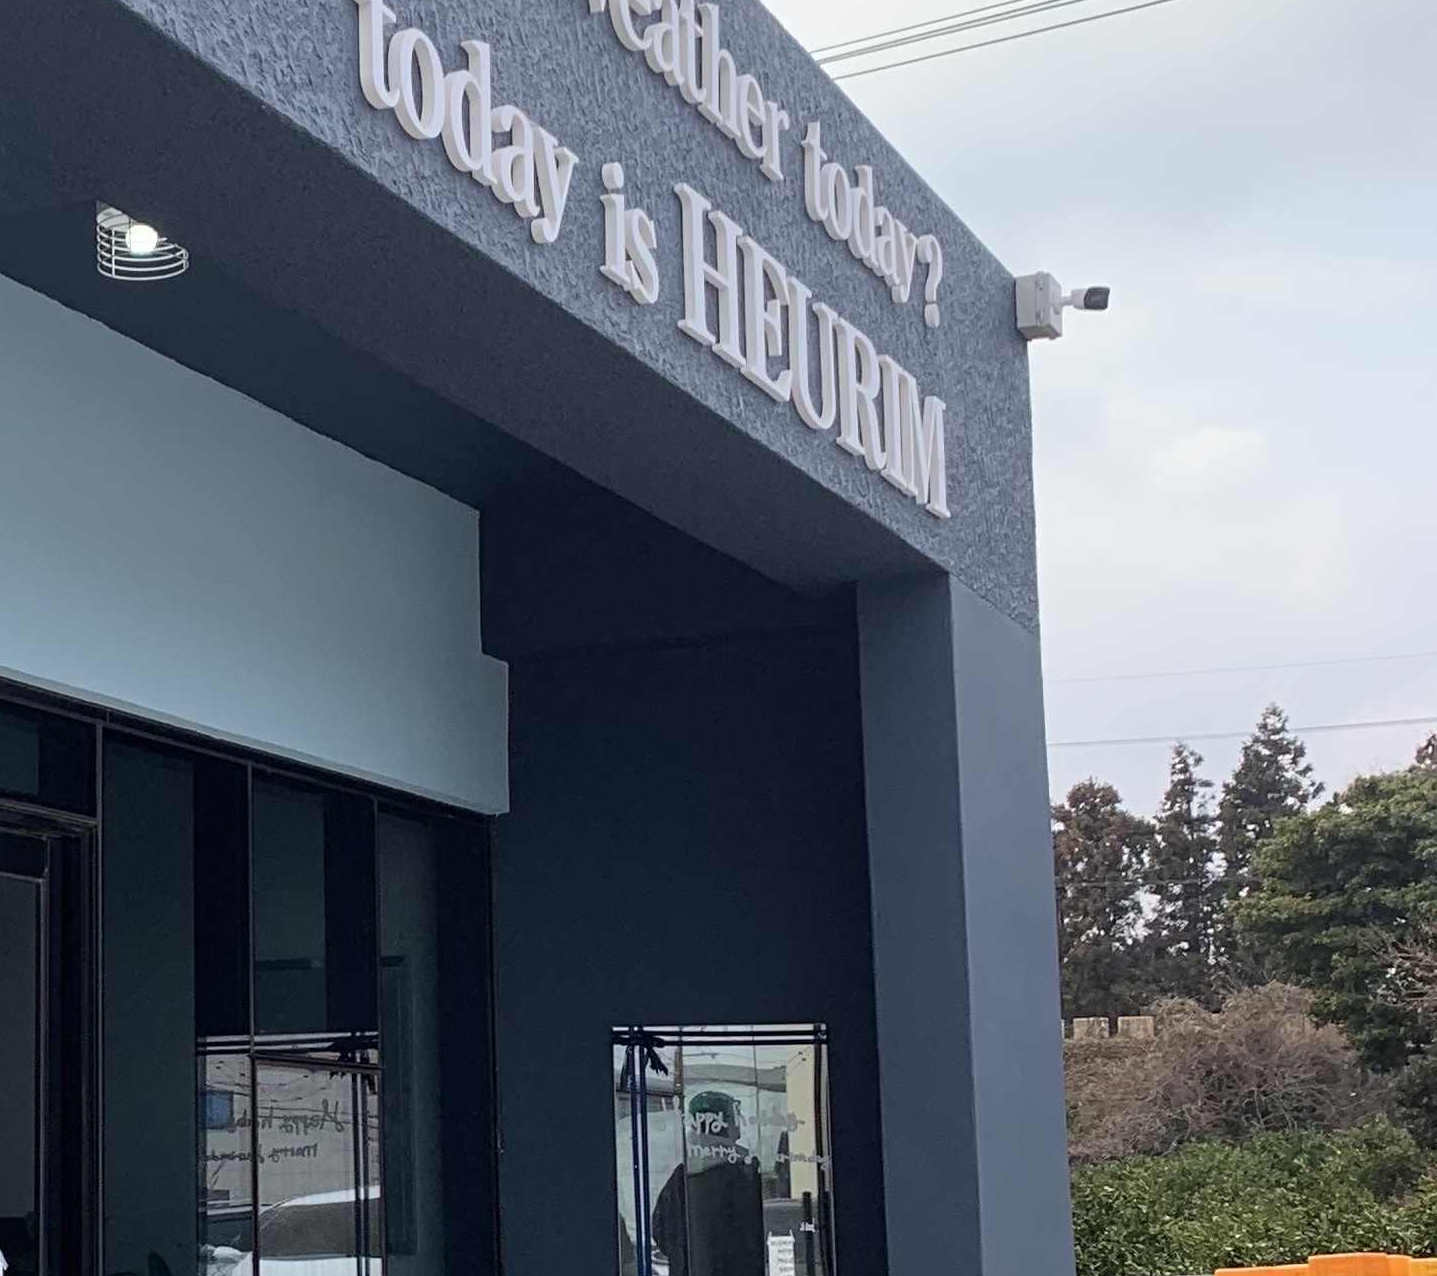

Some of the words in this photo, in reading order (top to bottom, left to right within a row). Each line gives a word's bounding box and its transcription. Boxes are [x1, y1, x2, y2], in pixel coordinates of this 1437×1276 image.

[600, 162, 660, 305] is
[676, 182, 952, 519] HEURIM
[800, 120, 944, 328] today?
